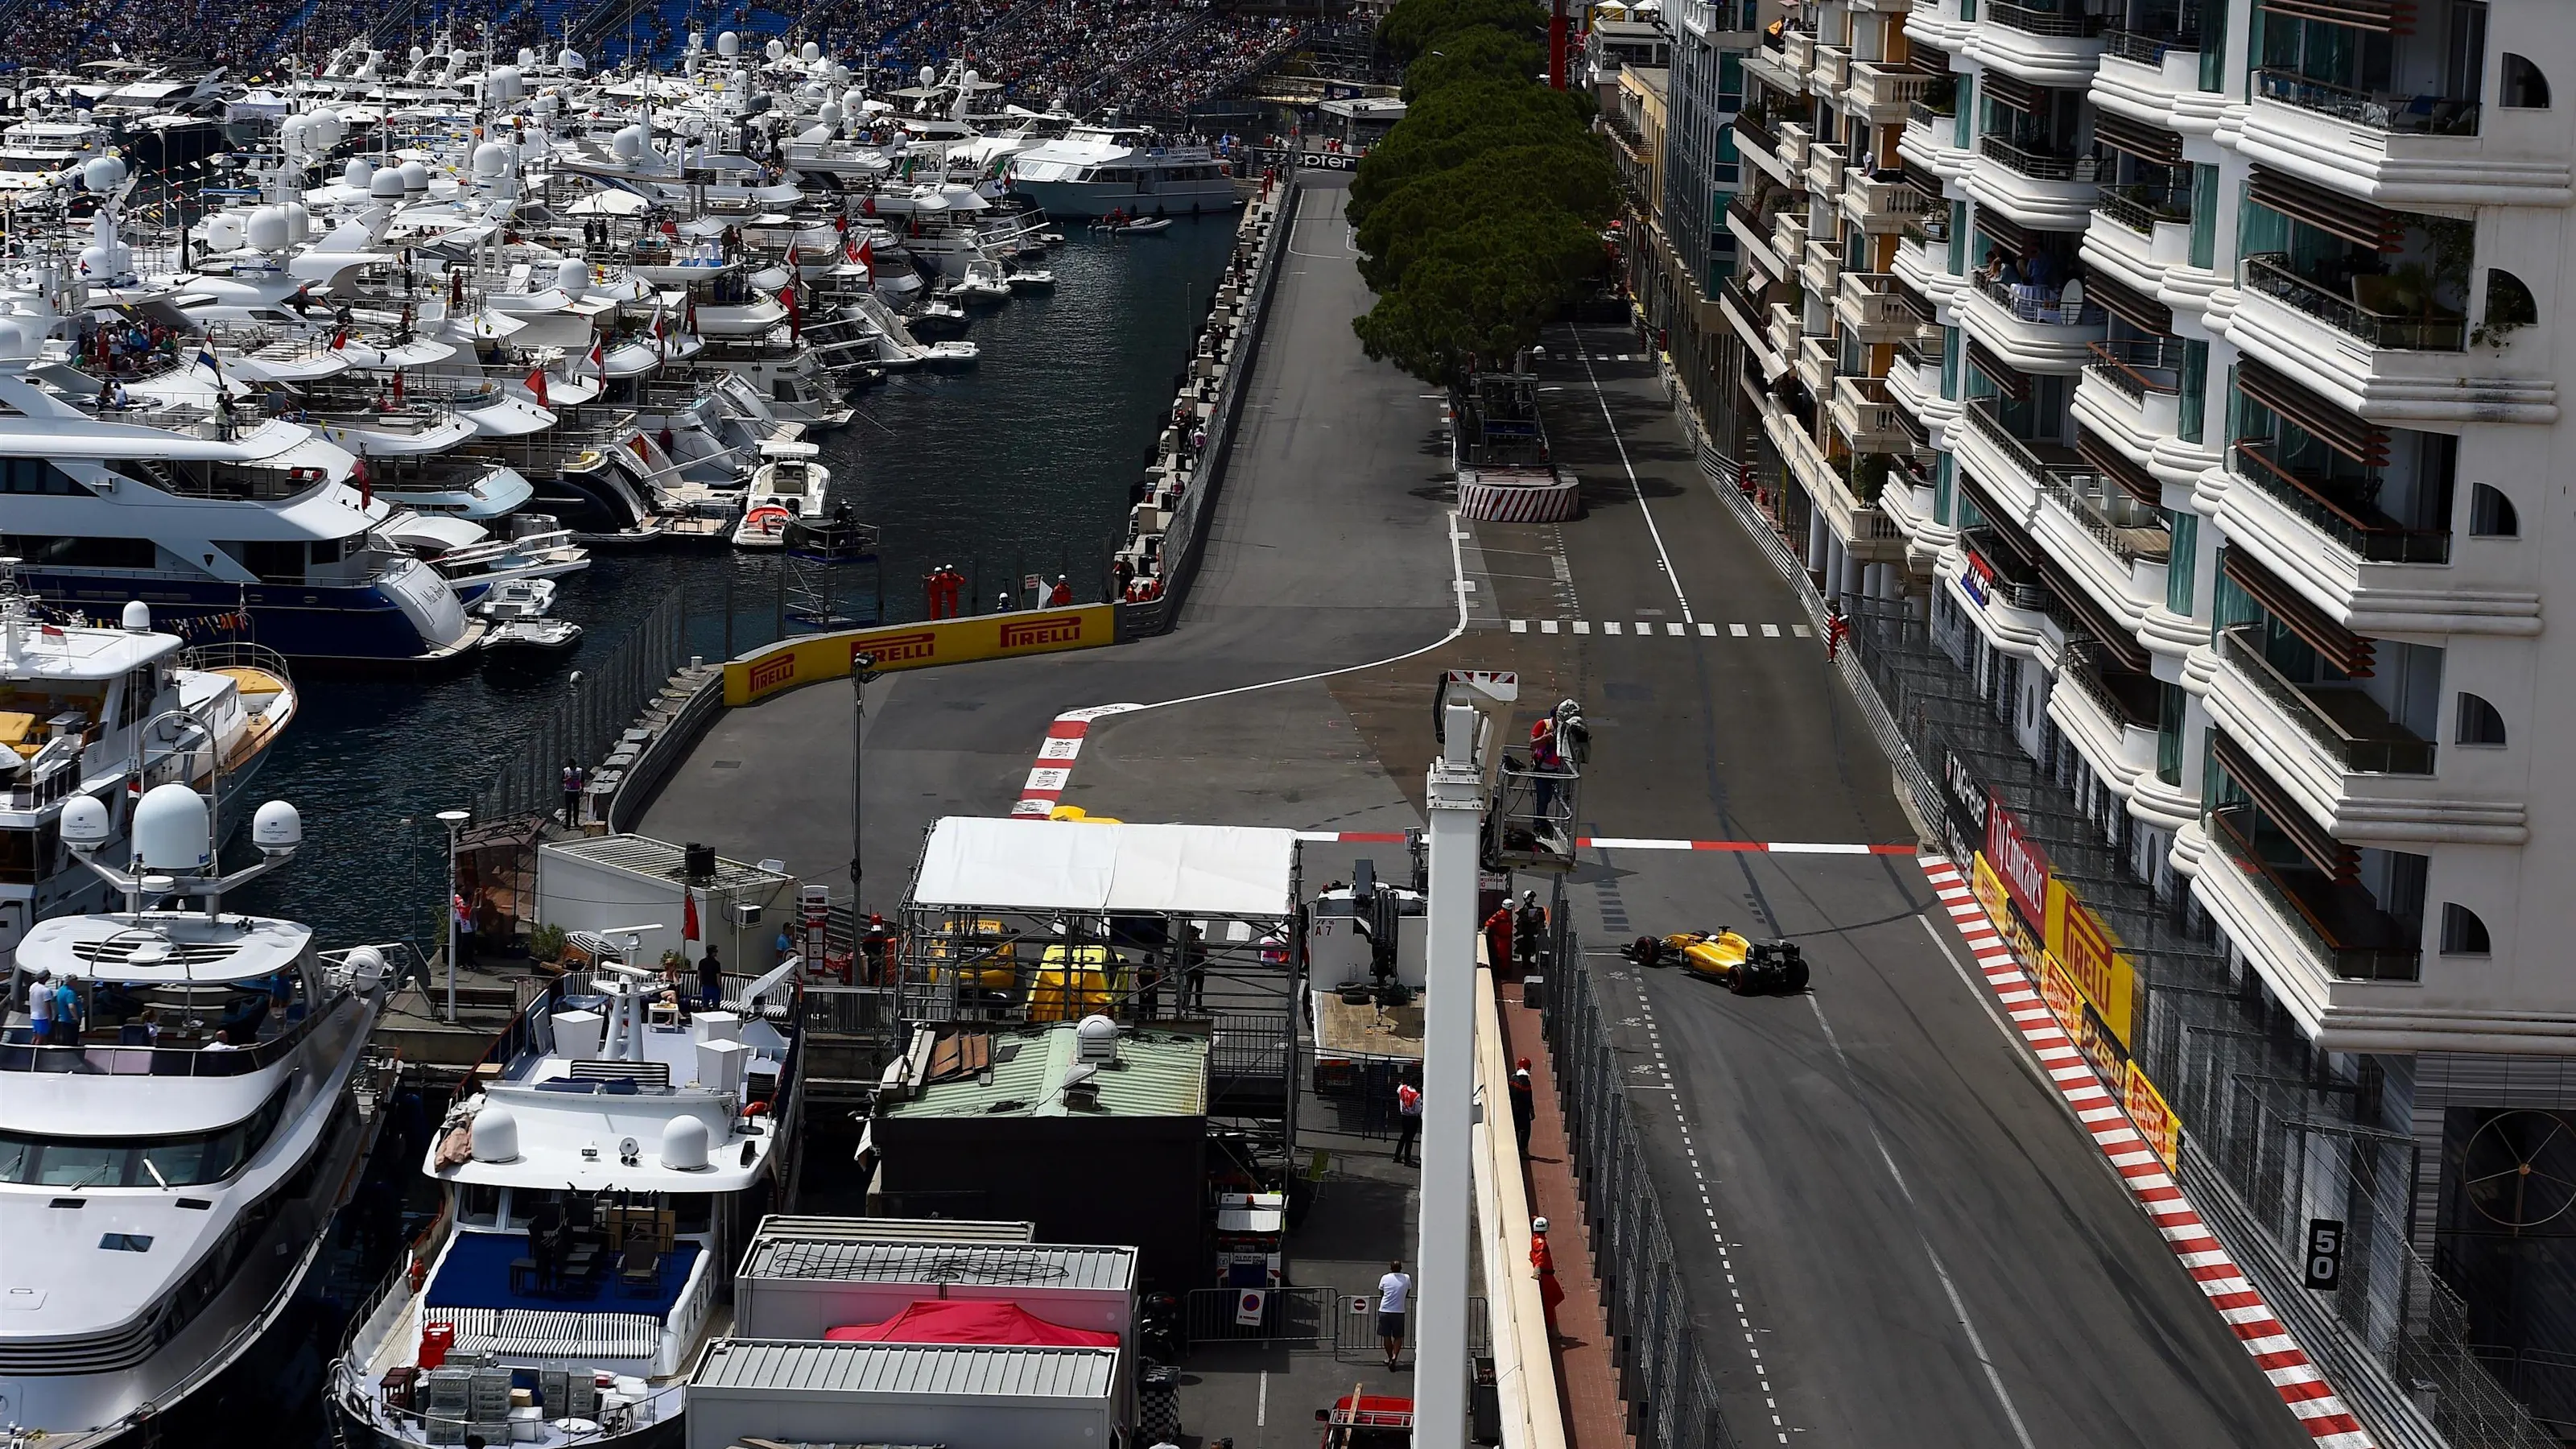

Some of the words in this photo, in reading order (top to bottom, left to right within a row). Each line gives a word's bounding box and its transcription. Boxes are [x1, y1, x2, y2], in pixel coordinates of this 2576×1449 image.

[851, 633, 935, 665] PRELLI
[1000, 617, 1081, 648] PIRELLI
[749, 653, 795, 692] PIRELLI
[1991, 800, 2005, 873] Fly
[2005, 820, 2043, 914] Emirates
[1315, 926, 1322, 936] A
[1326, 926, 1331, 936] 7
[2013, 921, 2041, 976] ZERO
[2062, 890, 2112, 1016] PIRELLI
[2083, 1019, 2092, 1041] P
[2091, 1030, 2124, 1088] ZERO
[2313, 1230, 2335, 1279] 50
